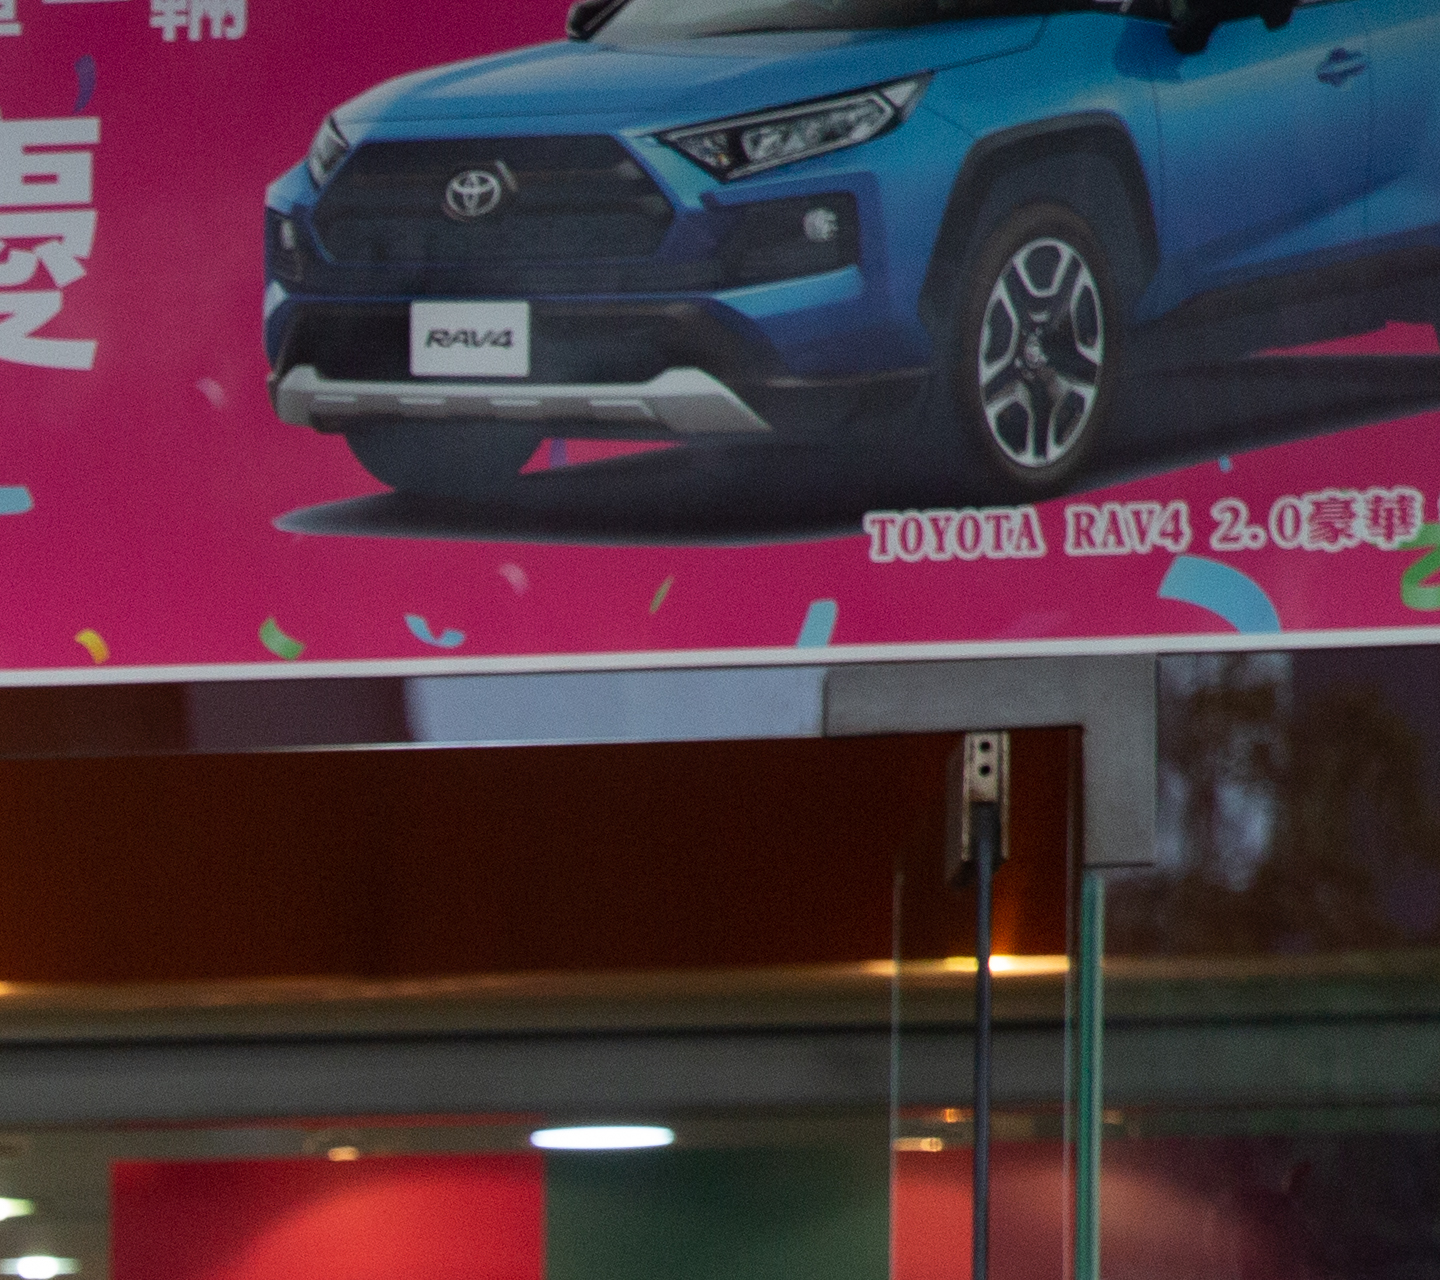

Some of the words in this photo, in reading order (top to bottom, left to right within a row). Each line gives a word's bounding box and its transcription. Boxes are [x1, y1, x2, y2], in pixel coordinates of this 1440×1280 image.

[424, 327, 515, 350] RAV4
[864, 502, 1047, 562] TOYOTA
[1064, 499, 1191, 557] RAV4
